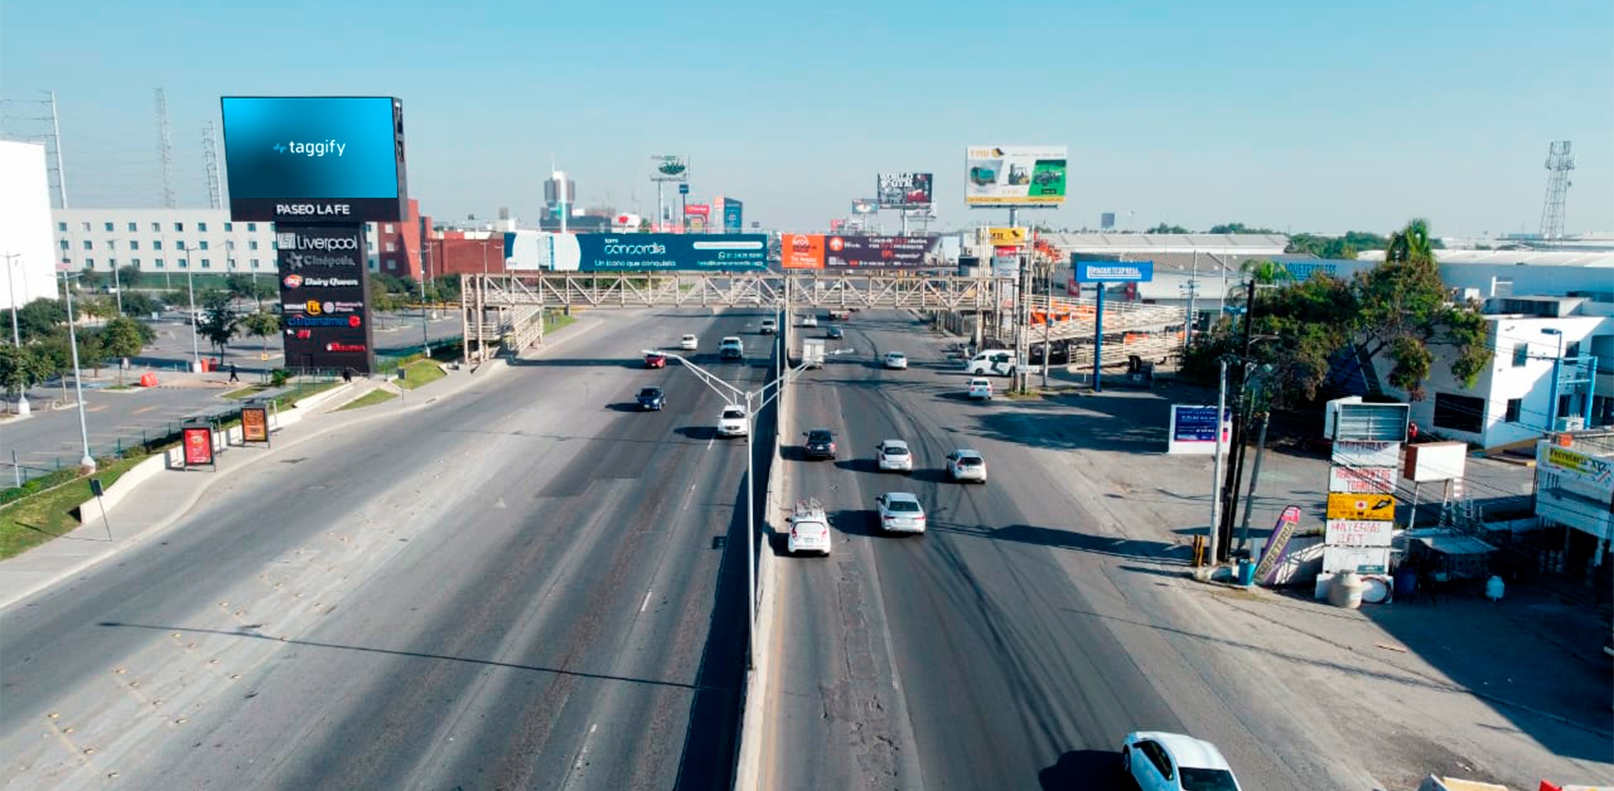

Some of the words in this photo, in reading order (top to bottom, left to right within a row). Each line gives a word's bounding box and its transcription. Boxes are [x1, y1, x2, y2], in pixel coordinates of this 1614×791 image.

[289, 139, 346, 157] taggify
[276, 204, 315, 215] PASEO
[316, 204, 334, 215] LA
[334, 204, 351, 215] FE
[296, 235, 358, 251] Liverpool
[604, 242, 666, 254] concordia
[304, 277, 328, 287] Dairy
[329, 277, 358, 287] Queen
